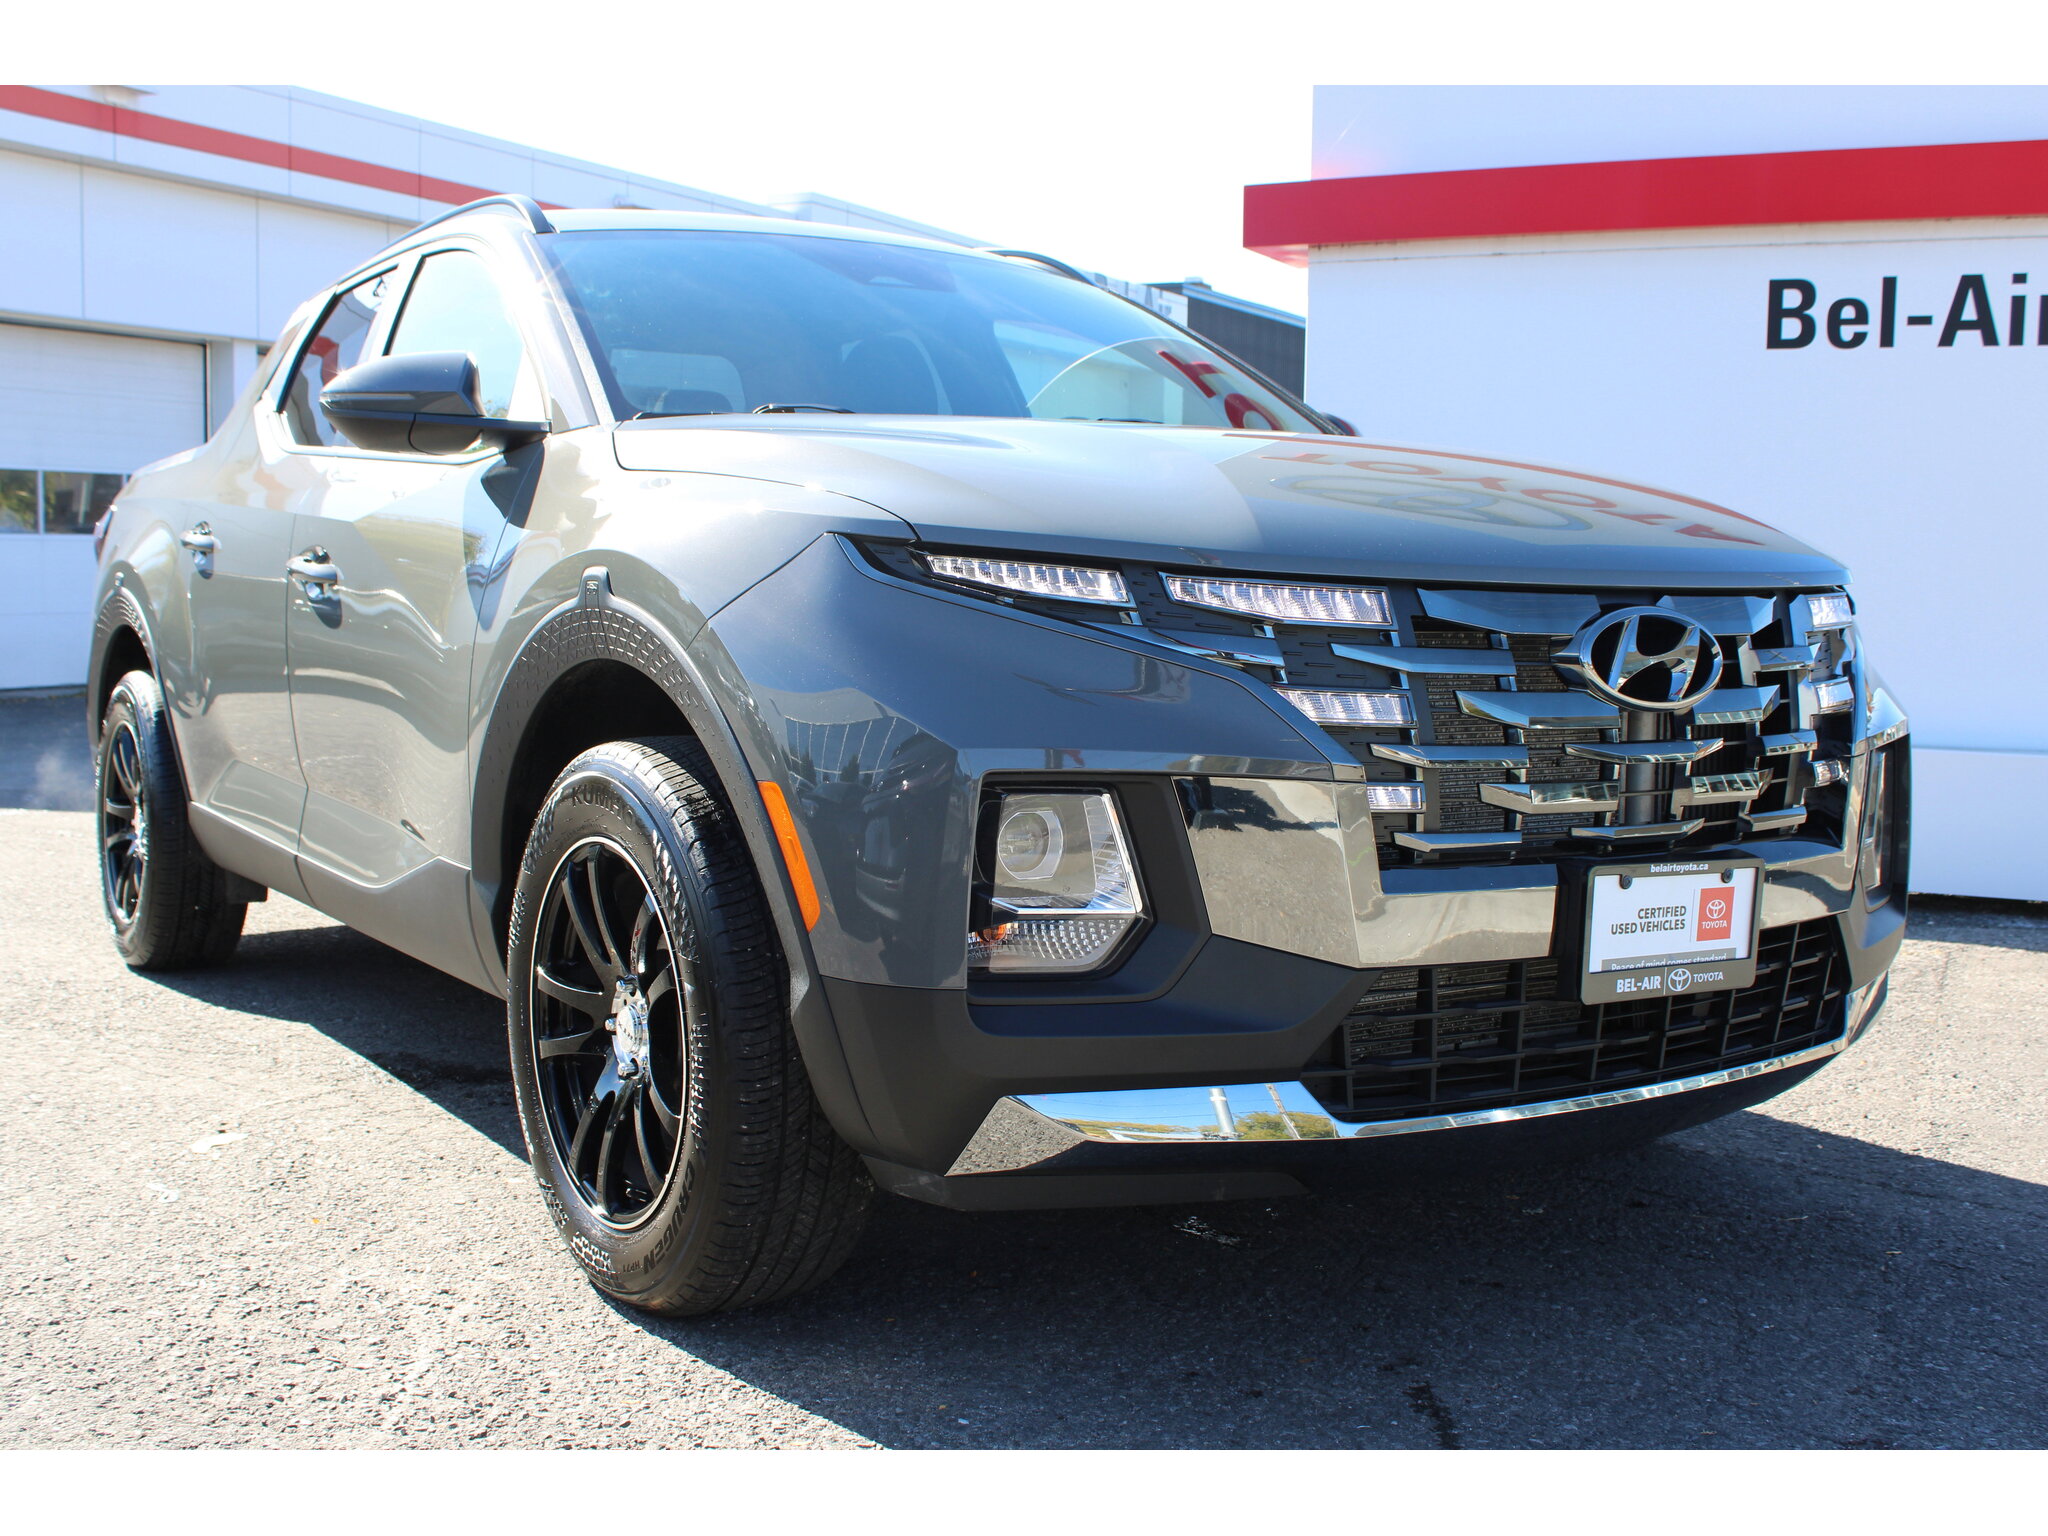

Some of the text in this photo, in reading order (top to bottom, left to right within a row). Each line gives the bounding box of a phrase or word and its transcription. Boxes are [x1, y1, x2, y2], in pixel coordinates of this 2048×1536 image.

[571, 783, 636, 832] KUMHO
[1650, 862, 1709, 874] belairtoyota.ca
[1637, 905, 1687, 920] CERTIFIED
[1611, 918, 1686, 935] USED VEHICLES
[1702, 920, 1728, 929] TOYOTA
[1616, 975, 1661, 993] BEL-AIR
[1693, 971, 1724, 983] TOYOTA
